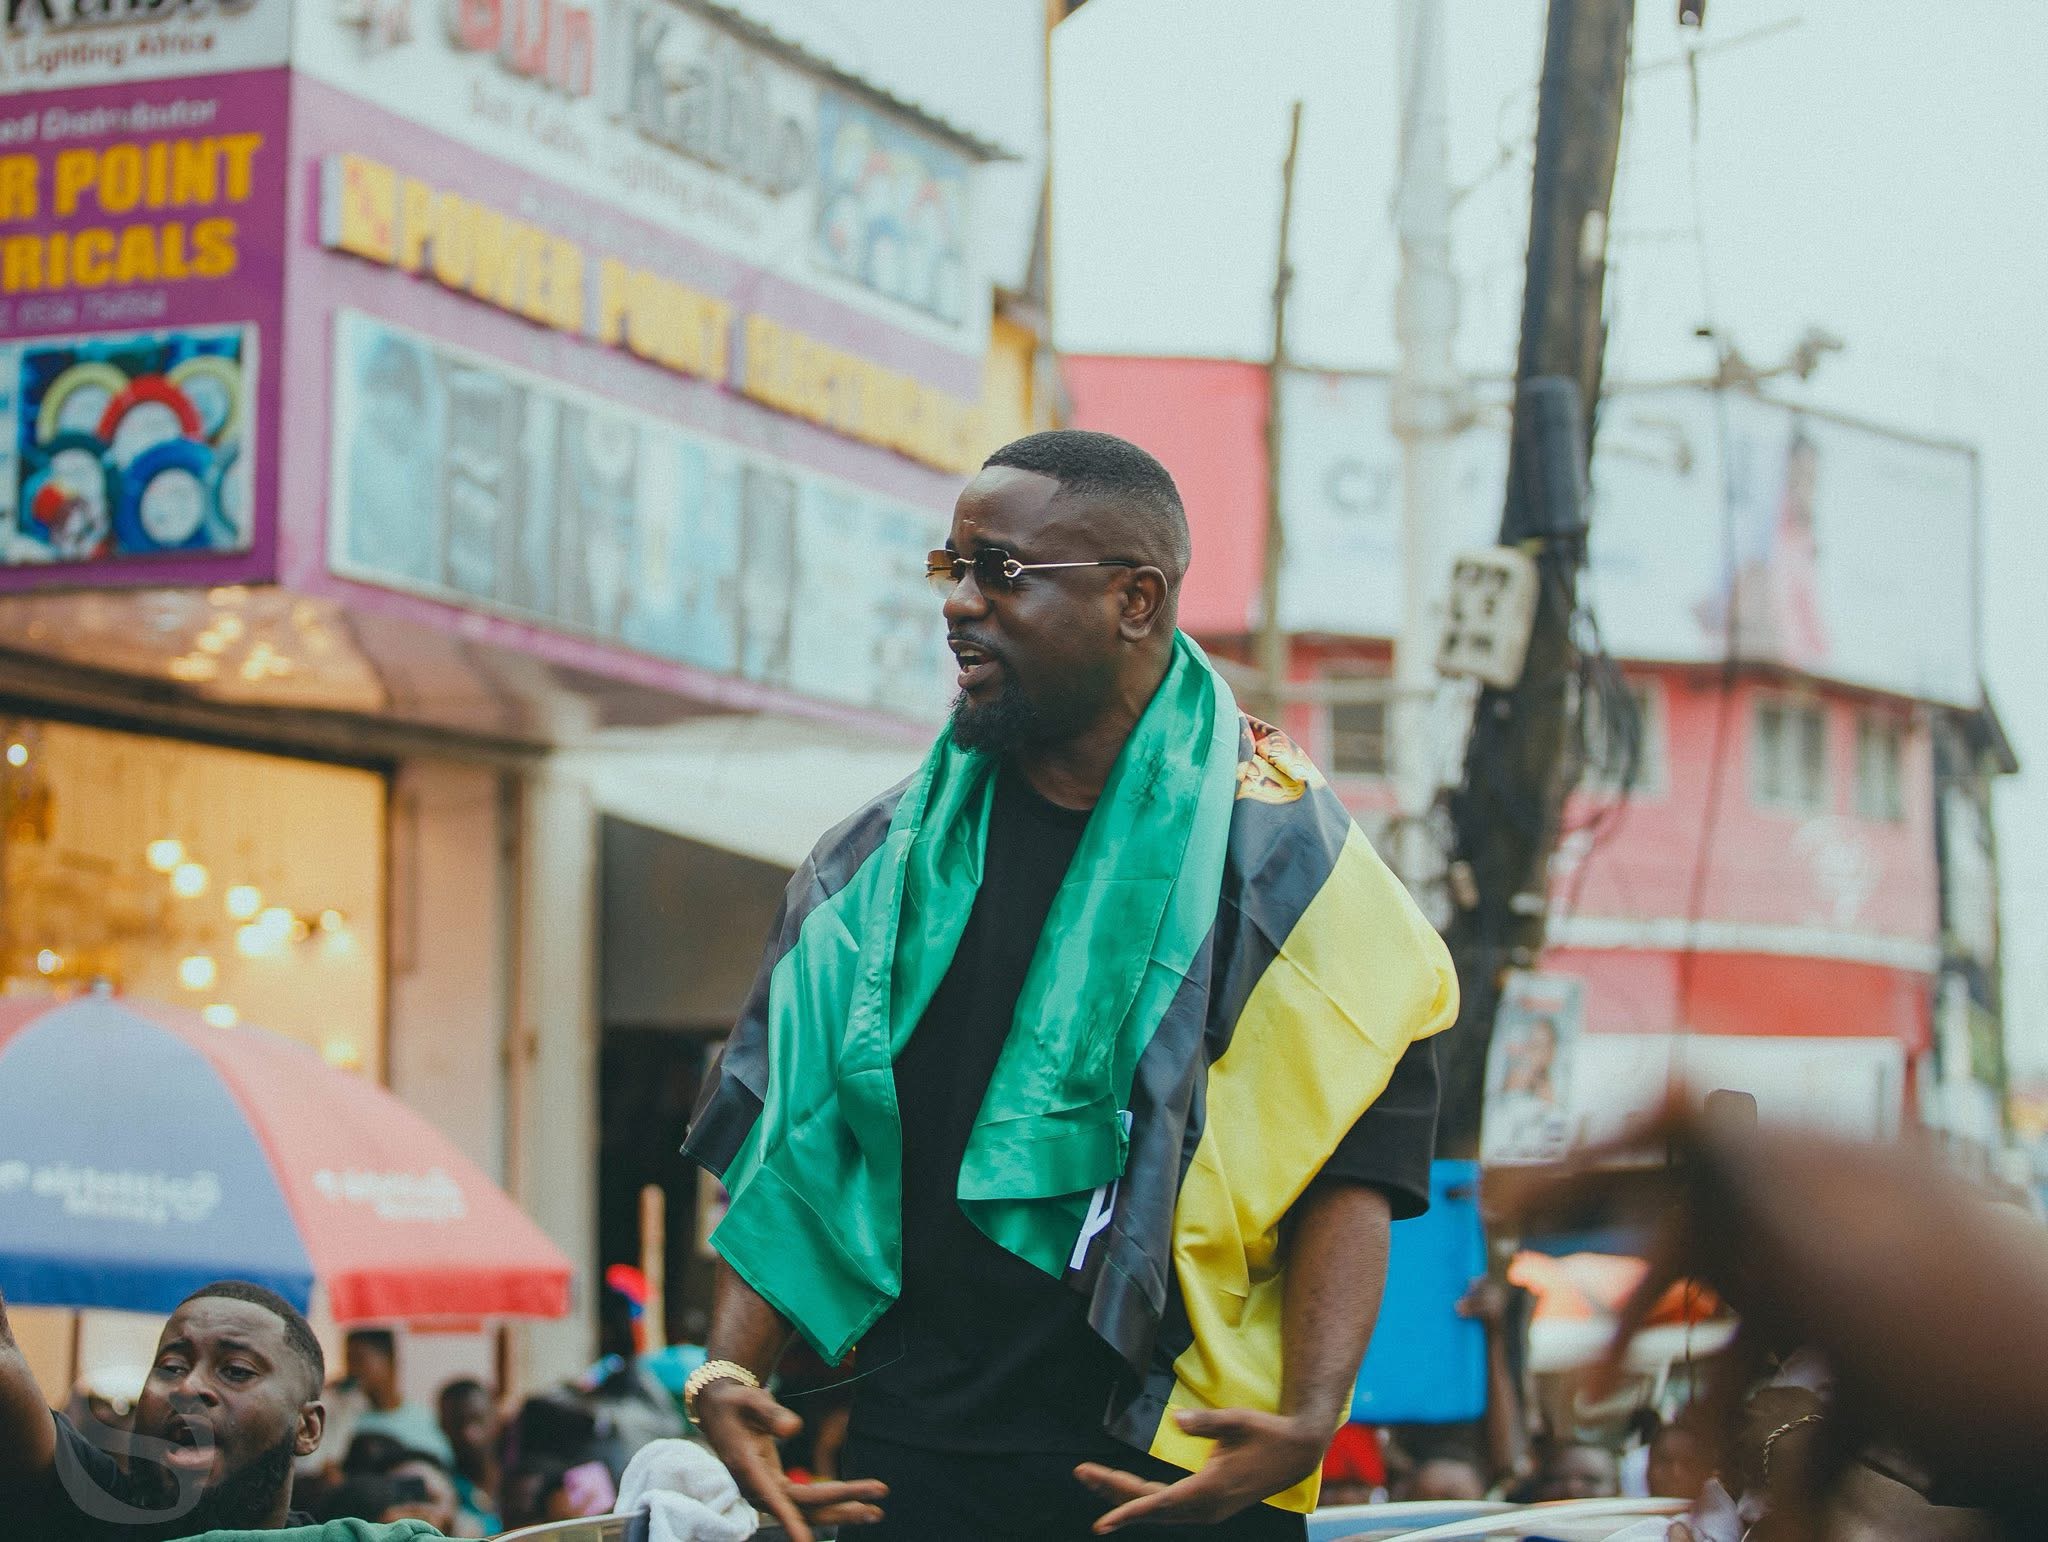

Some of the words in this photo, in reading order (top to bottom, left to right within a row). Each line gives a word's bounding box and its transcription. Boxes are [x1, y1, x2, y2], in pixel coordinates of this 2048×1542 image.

[54, 133, 263, 217] POINT
[0, 216, 238, 294] RICALS
[402, 176, 584, 336] POWER
[601, 254, 732, 385] POINT
